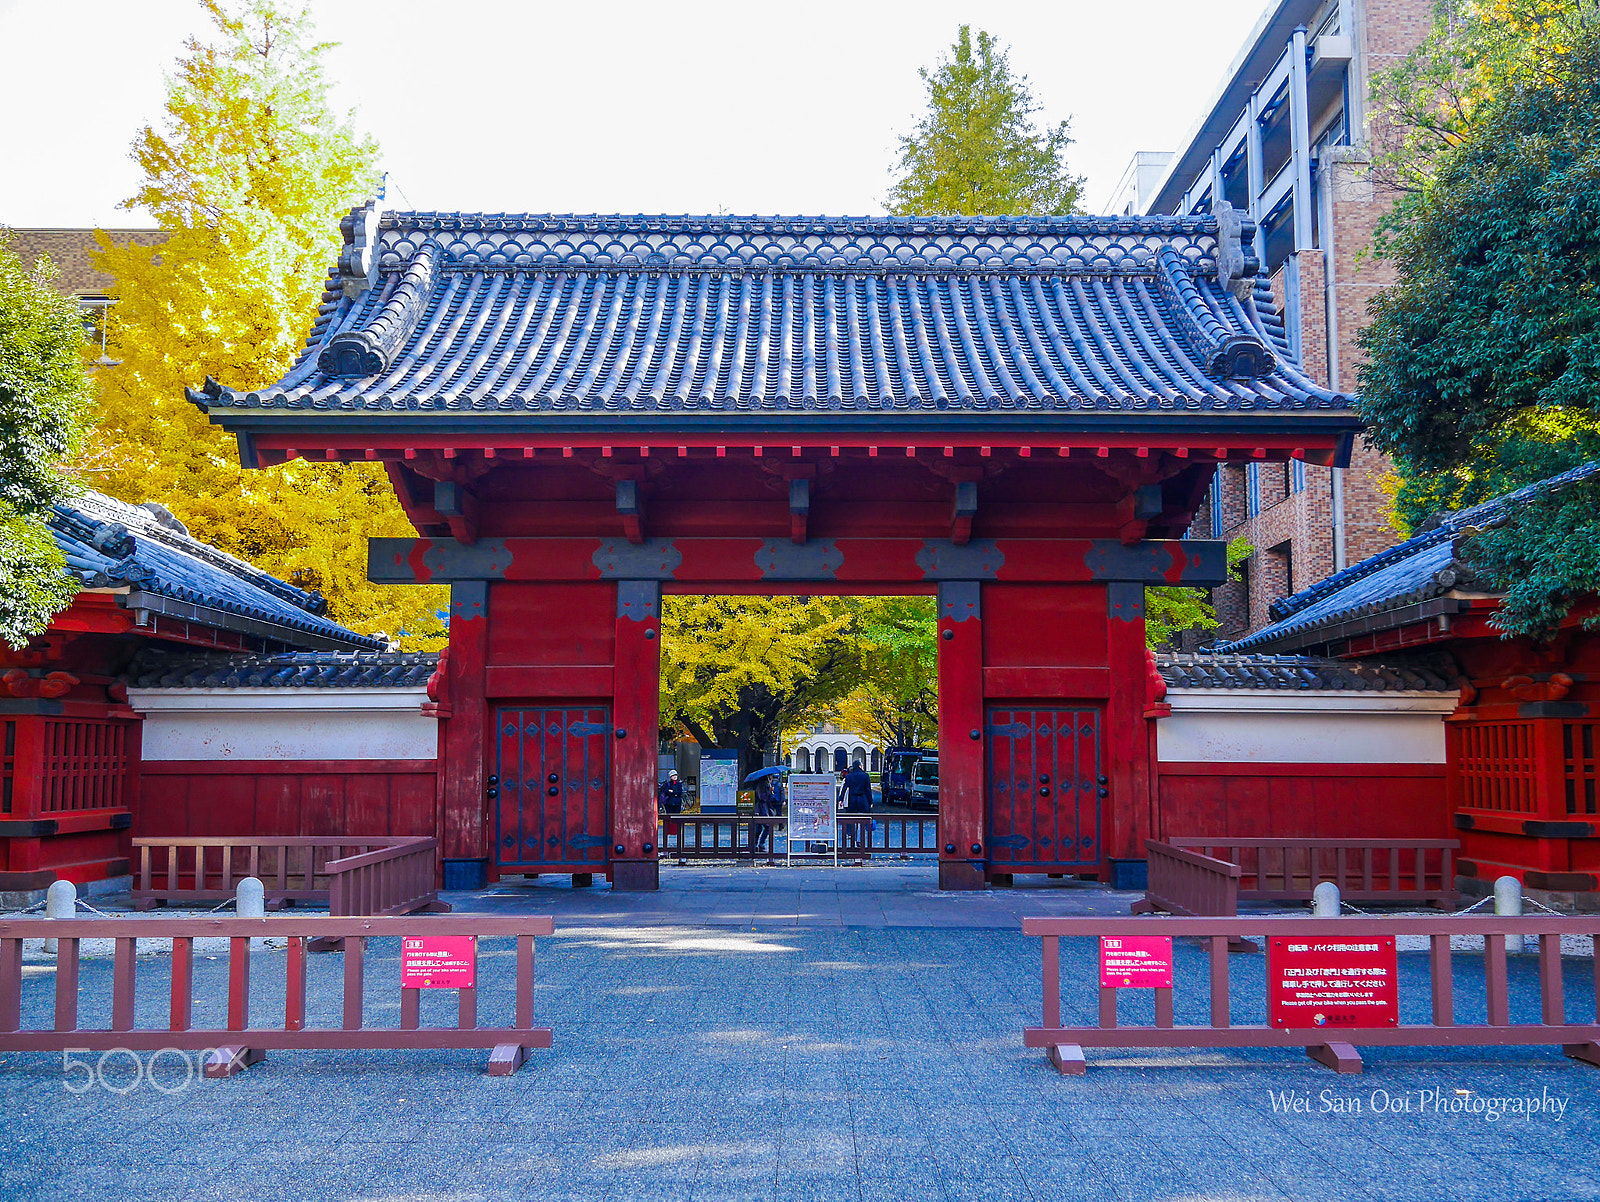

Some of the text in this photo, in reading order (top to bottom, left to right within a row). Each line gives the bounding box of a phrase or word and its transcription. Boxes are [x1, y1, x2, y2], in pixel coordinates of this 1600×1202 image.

[1288, 944, 1379, 952] 自転車・バイク利用の注意事項
